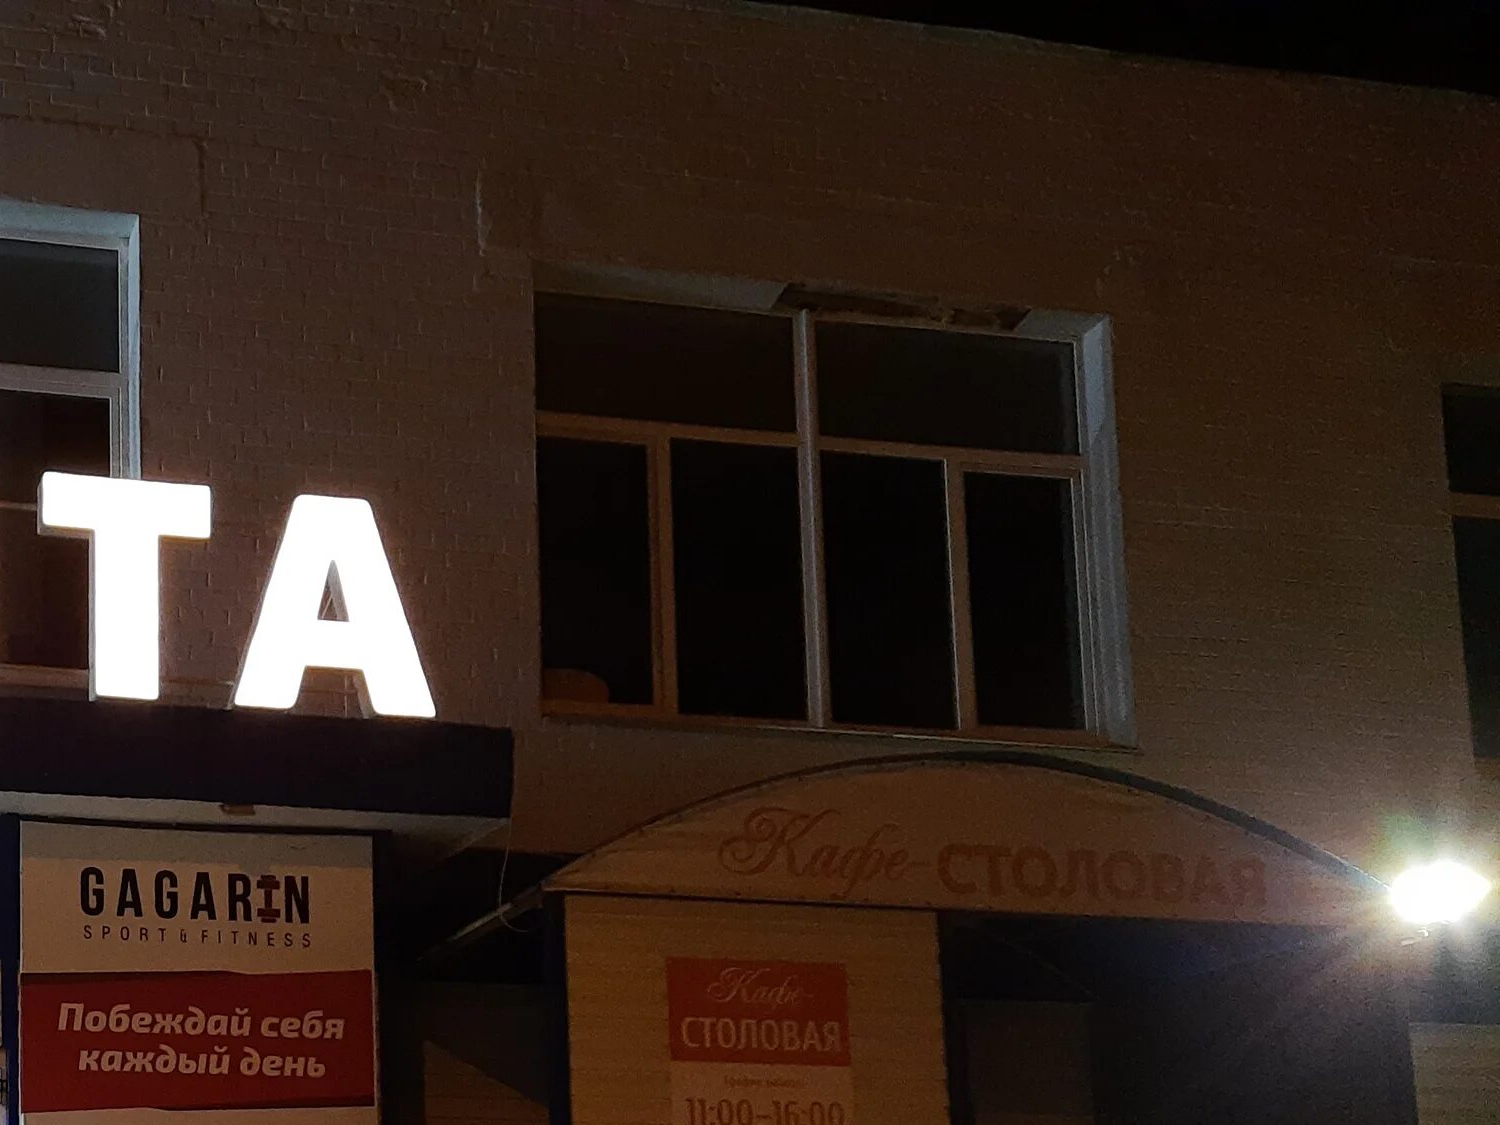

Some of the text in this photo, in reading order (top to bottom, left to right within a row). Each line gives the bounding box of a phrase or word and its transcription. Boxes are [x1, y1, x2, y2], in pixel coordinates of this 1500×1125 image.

[79, 867, 310, 924] GAGARIN
[57, 1002, 346, 1039] Побеждай себя
[680, 1016, 841, 1052] СТОЛОВАЯ
[78, 1045, 327, 1078] каждый день
